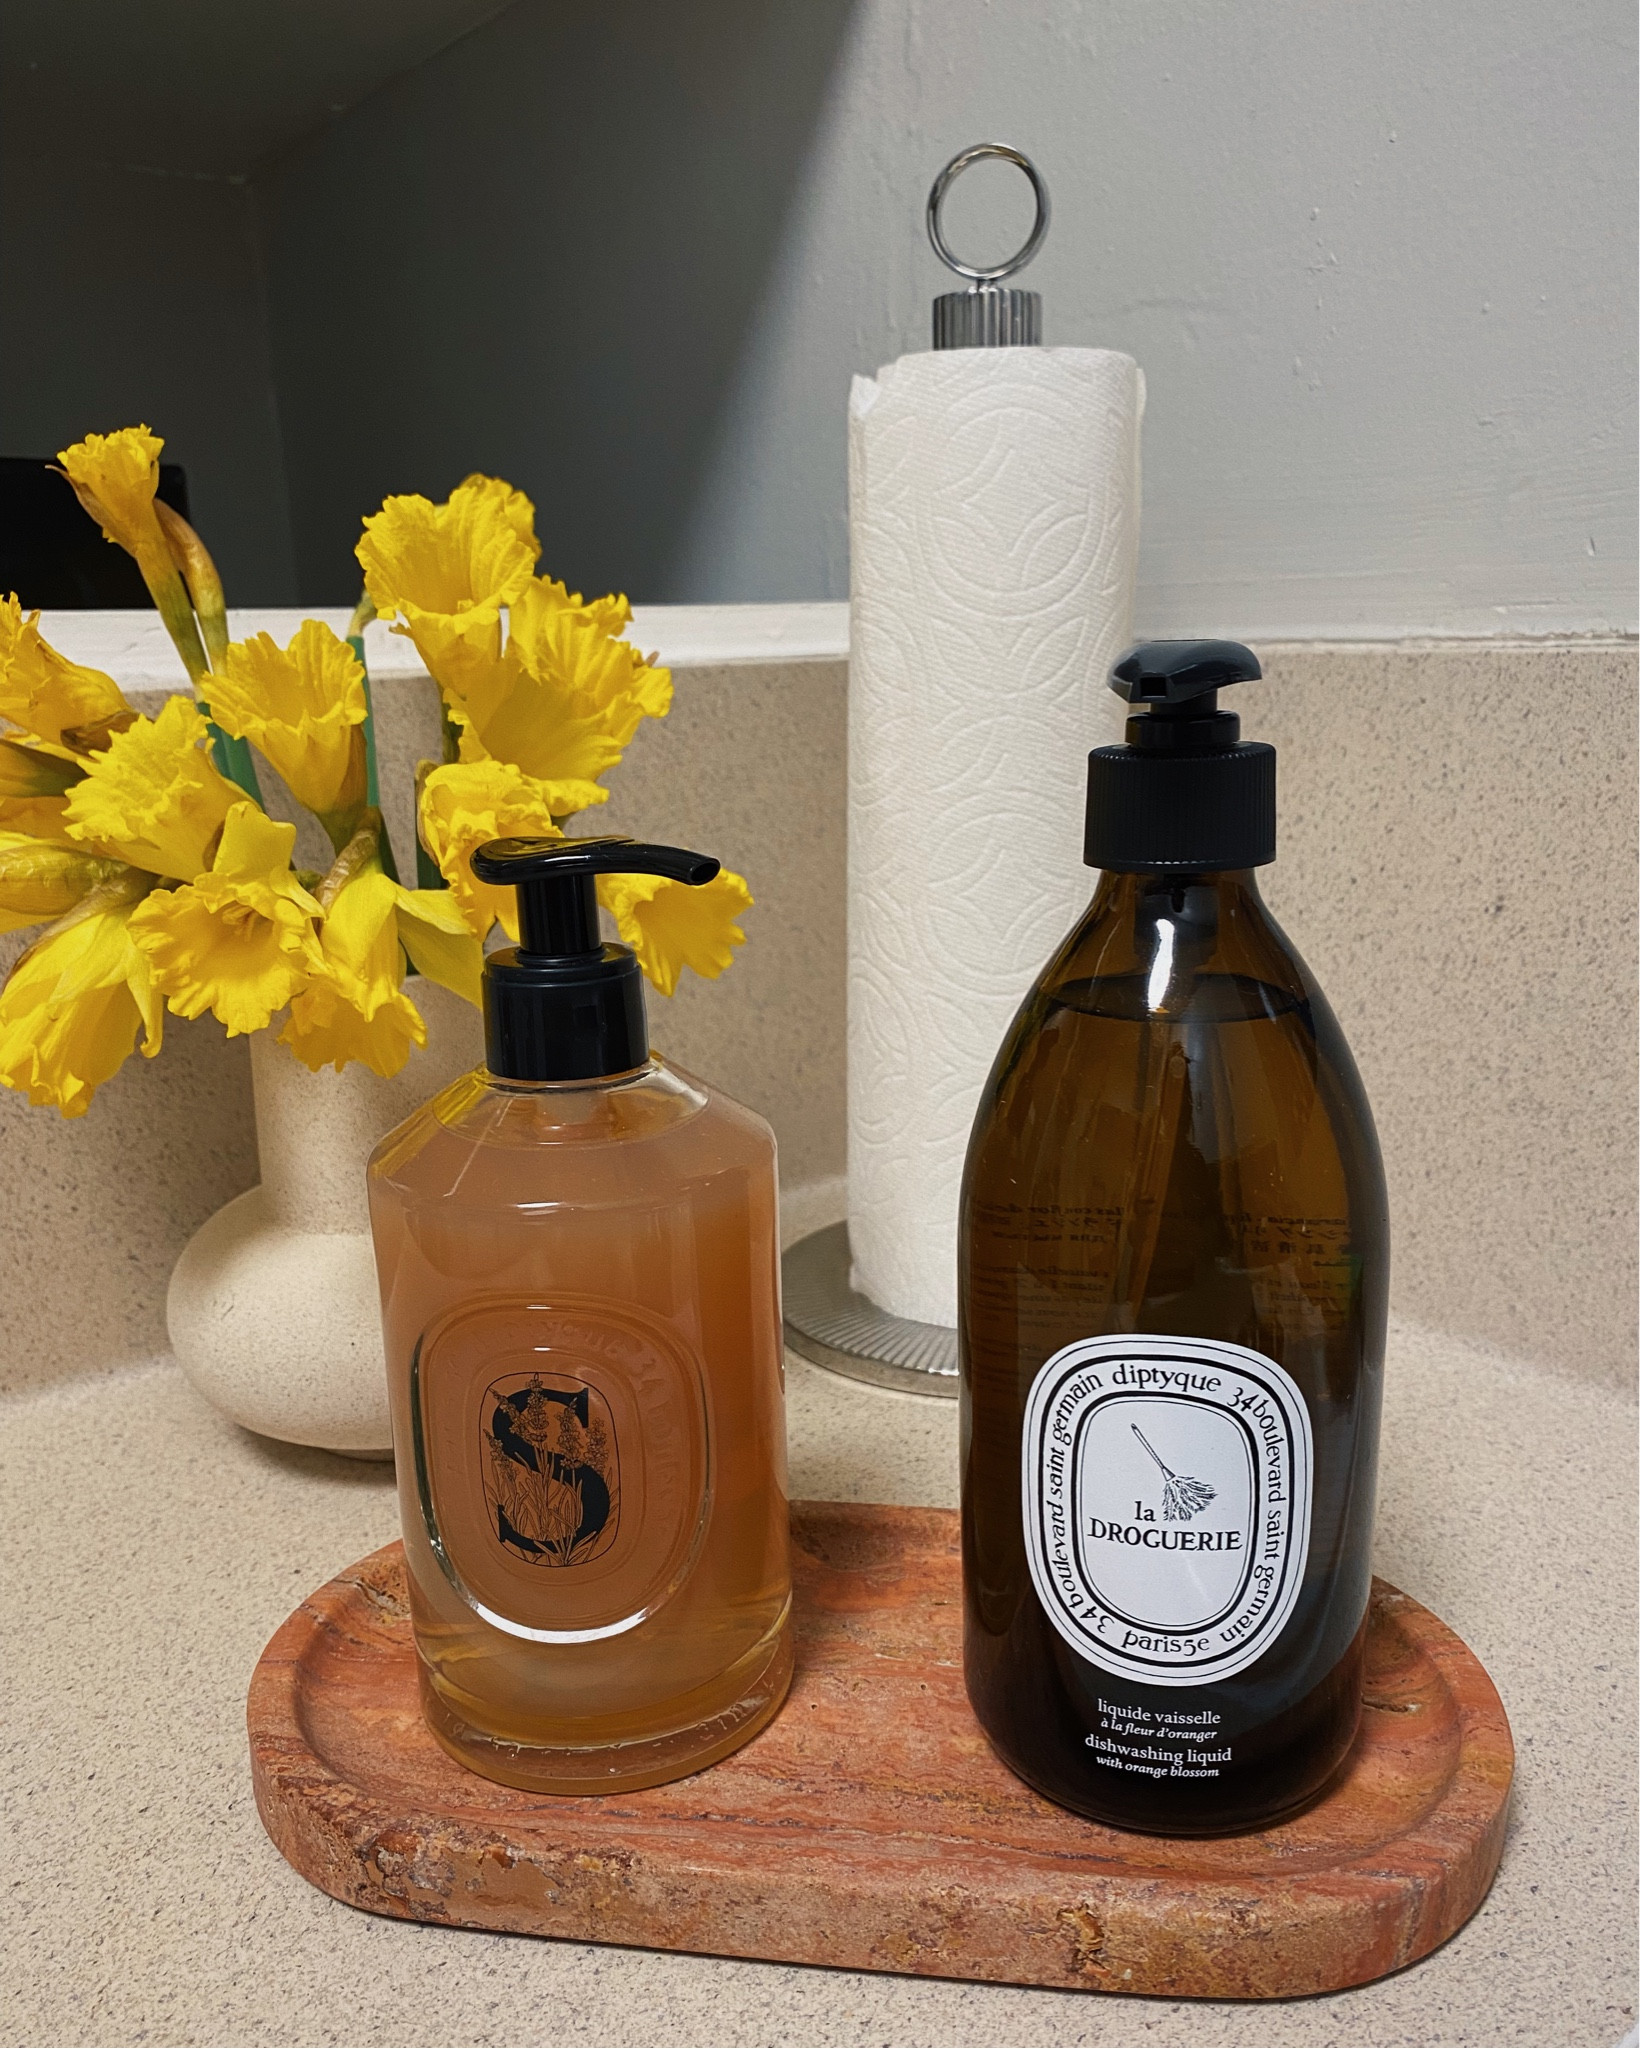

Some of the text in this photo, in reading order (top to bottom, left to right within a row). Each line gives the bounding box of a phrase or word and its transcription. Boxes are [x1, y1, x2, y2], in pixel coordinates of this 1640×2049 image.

[1112, 1363, 1221, 1392] diptyque
[1053, 1373, 1104, 1446] germain
[492, 1387, 611, 1553] S
[1046, 1447, 1066, 1500] saint
[1135, 1501, 1156, 1522] la
[1087, 1517, 1243, 1551] DROGUERIE
[1266, 1510, 1287, 1560] saint
[1219, 1565, 1275, 1642] germain
[1098, 1698, 1221, 1724] liquide vaisselle
[1100, 1718, 1109, 1728] à
[1111, 1718, 1123, 1731] la
[1122, 1722, 1155, 1736] fleur
[1084, 1734, 1232, 1766] dishwashing liquid
[1096, 1755, 1220, 1778] with orange blossom
